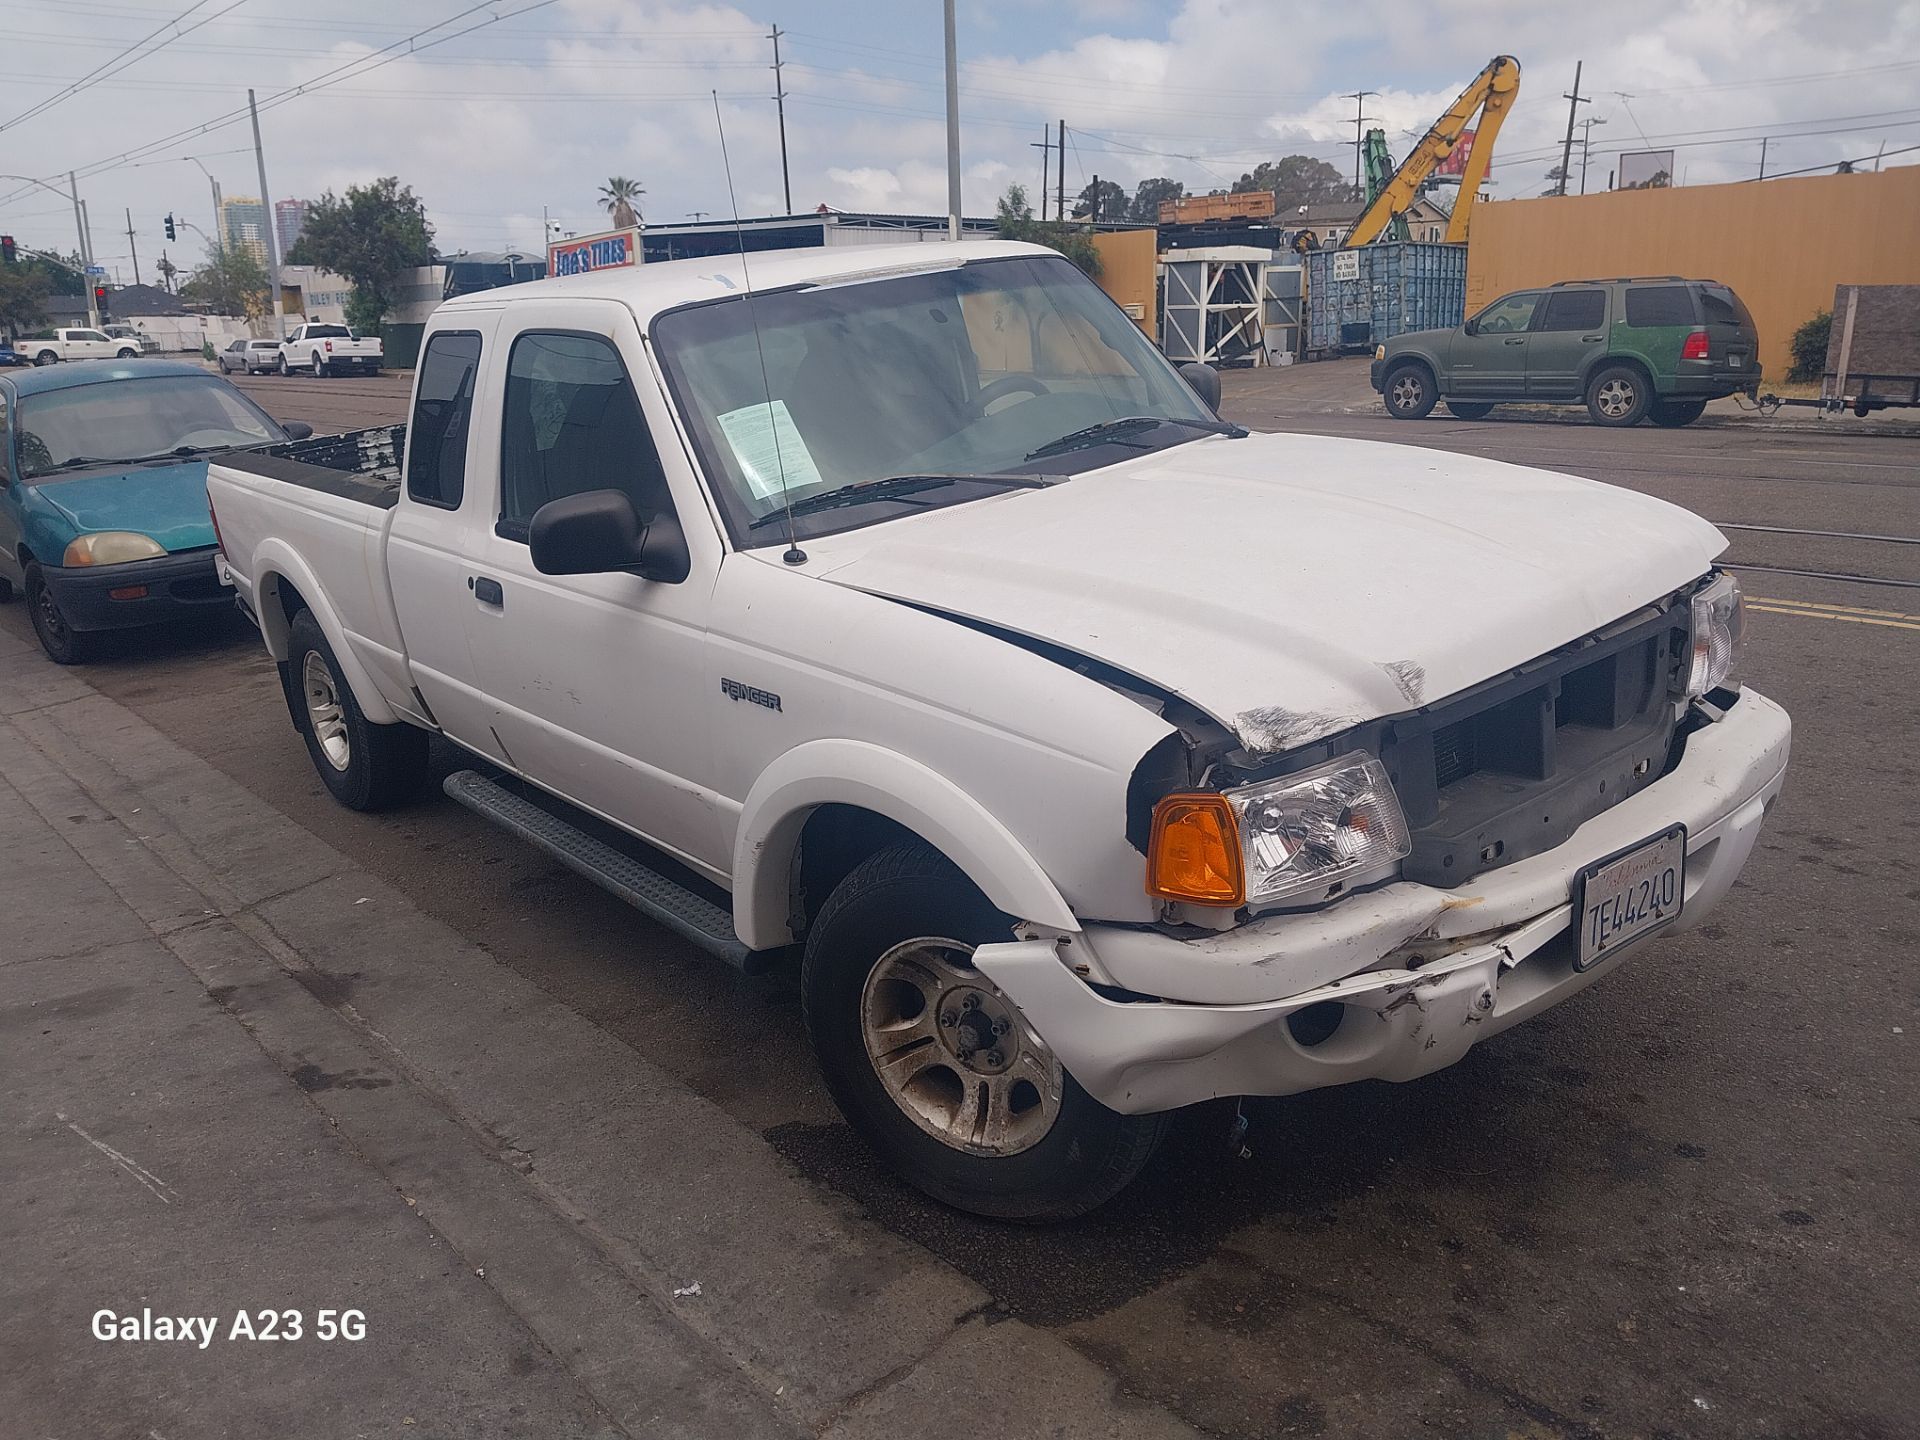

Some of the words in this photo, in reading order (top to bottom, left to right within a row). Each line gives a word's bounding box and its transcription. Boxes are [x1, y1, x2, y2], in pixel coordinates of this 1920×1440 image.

[589, 238, 625, 268] TIRES
[720, 677, 783, 713] RANGER
[1589, 867, 1675, 948] 7E44240
